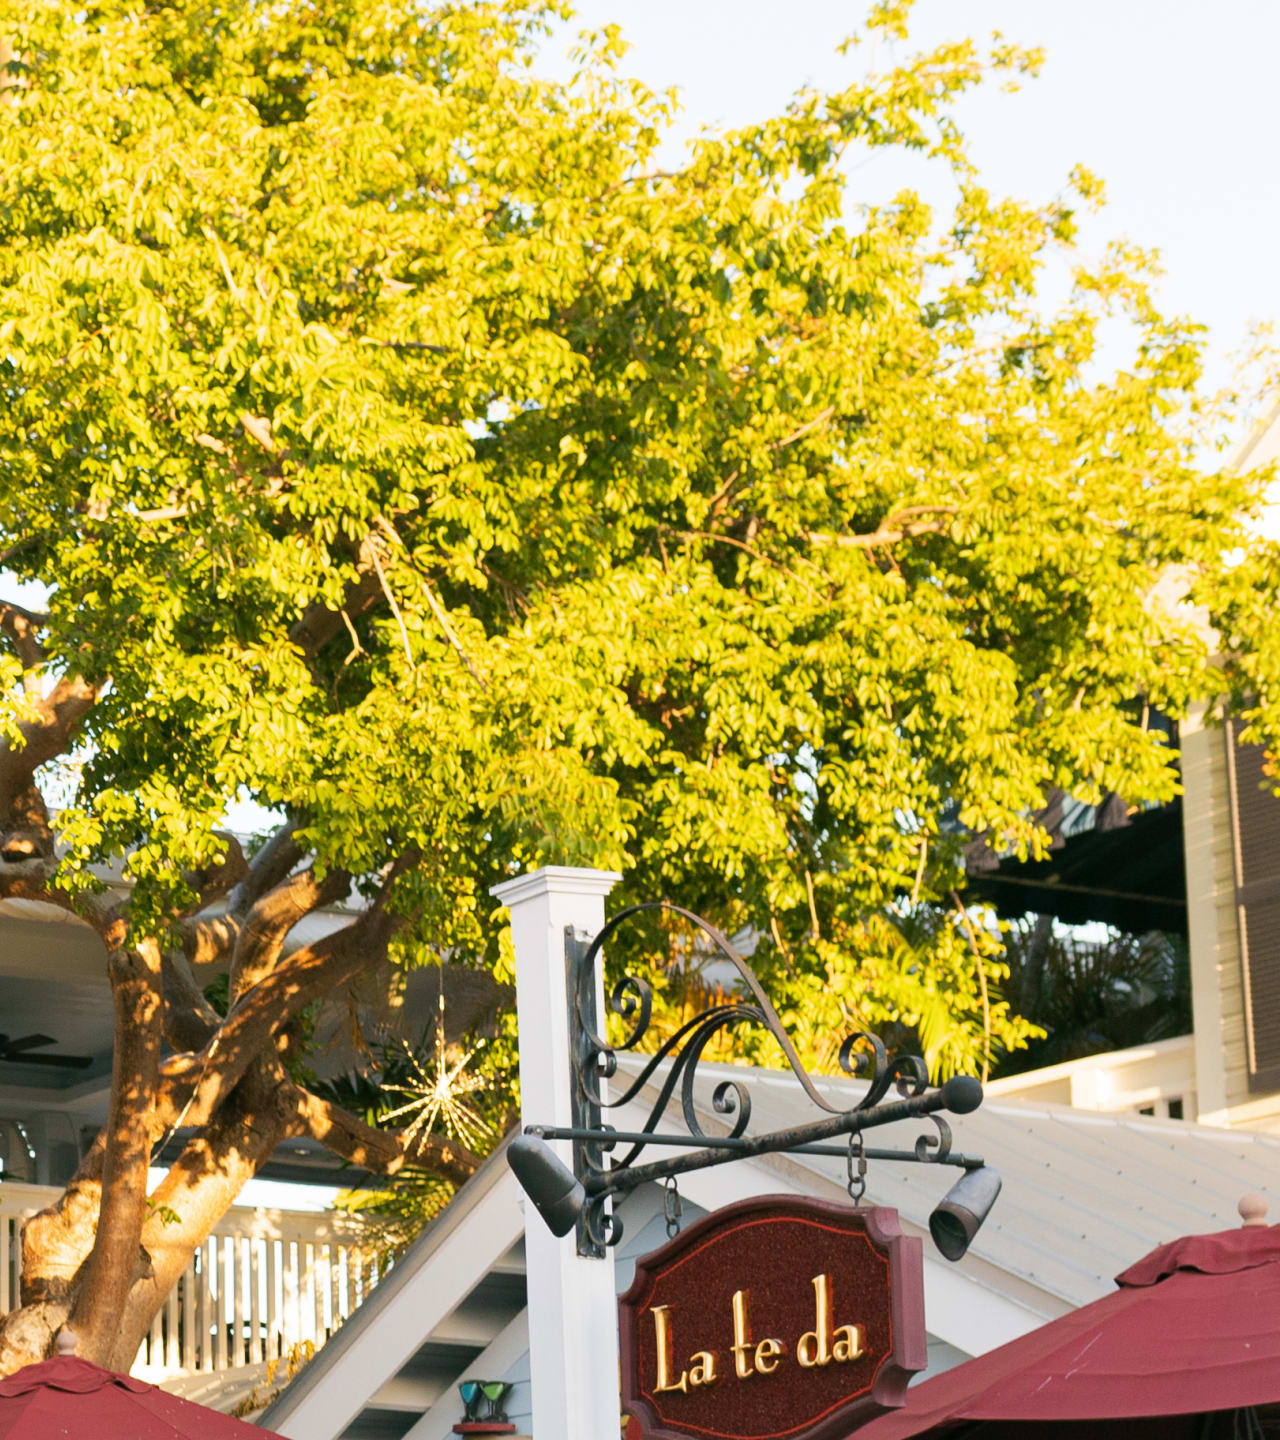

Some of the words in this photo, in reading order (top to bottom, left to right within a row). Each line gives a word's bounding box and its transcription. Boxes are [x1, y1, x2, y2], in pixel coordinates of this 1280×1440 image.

[650, 1304, 717, 1394] La
[730, 1289, 785, 1379] te
[797, 1273, 865, 1368] da
